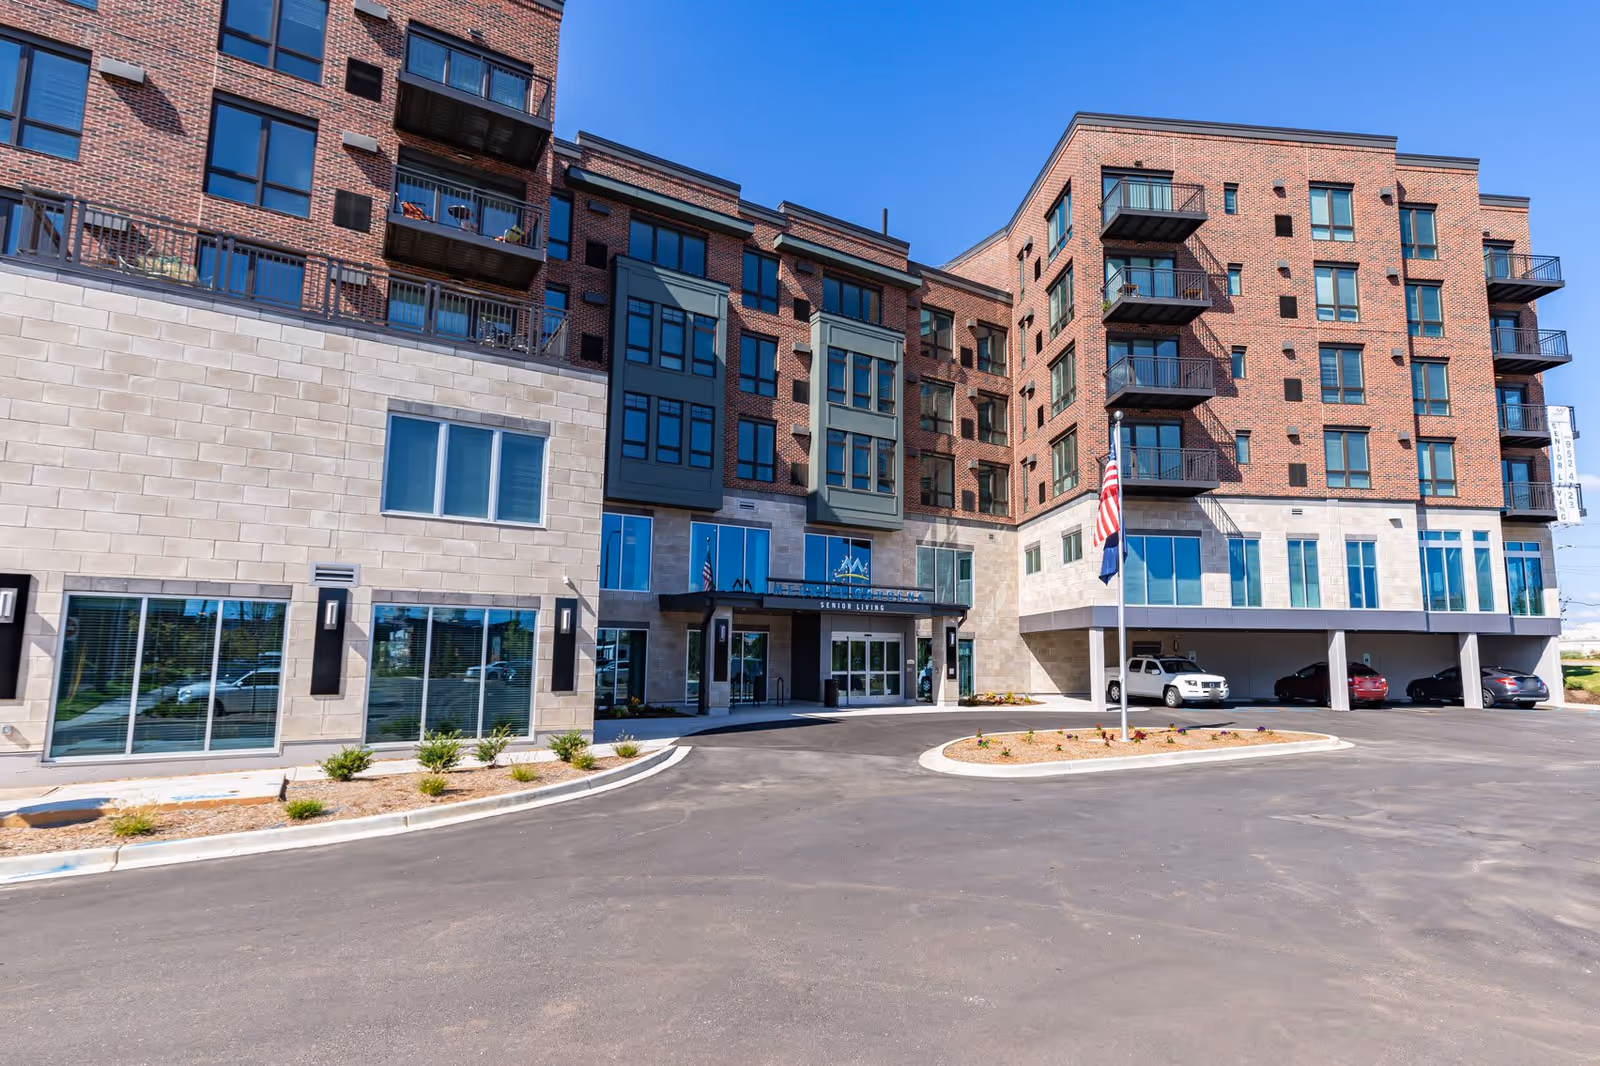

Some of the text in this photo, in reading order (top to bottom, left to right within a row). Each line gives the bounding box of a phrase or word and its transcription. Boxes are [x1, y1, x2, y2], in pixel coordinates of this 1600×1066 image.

[1552, 422, 1562, 469] SENIOR
[1565, 440, 1573, 468] 952
[820, 601, 885, 611] SENIOR LIVING
